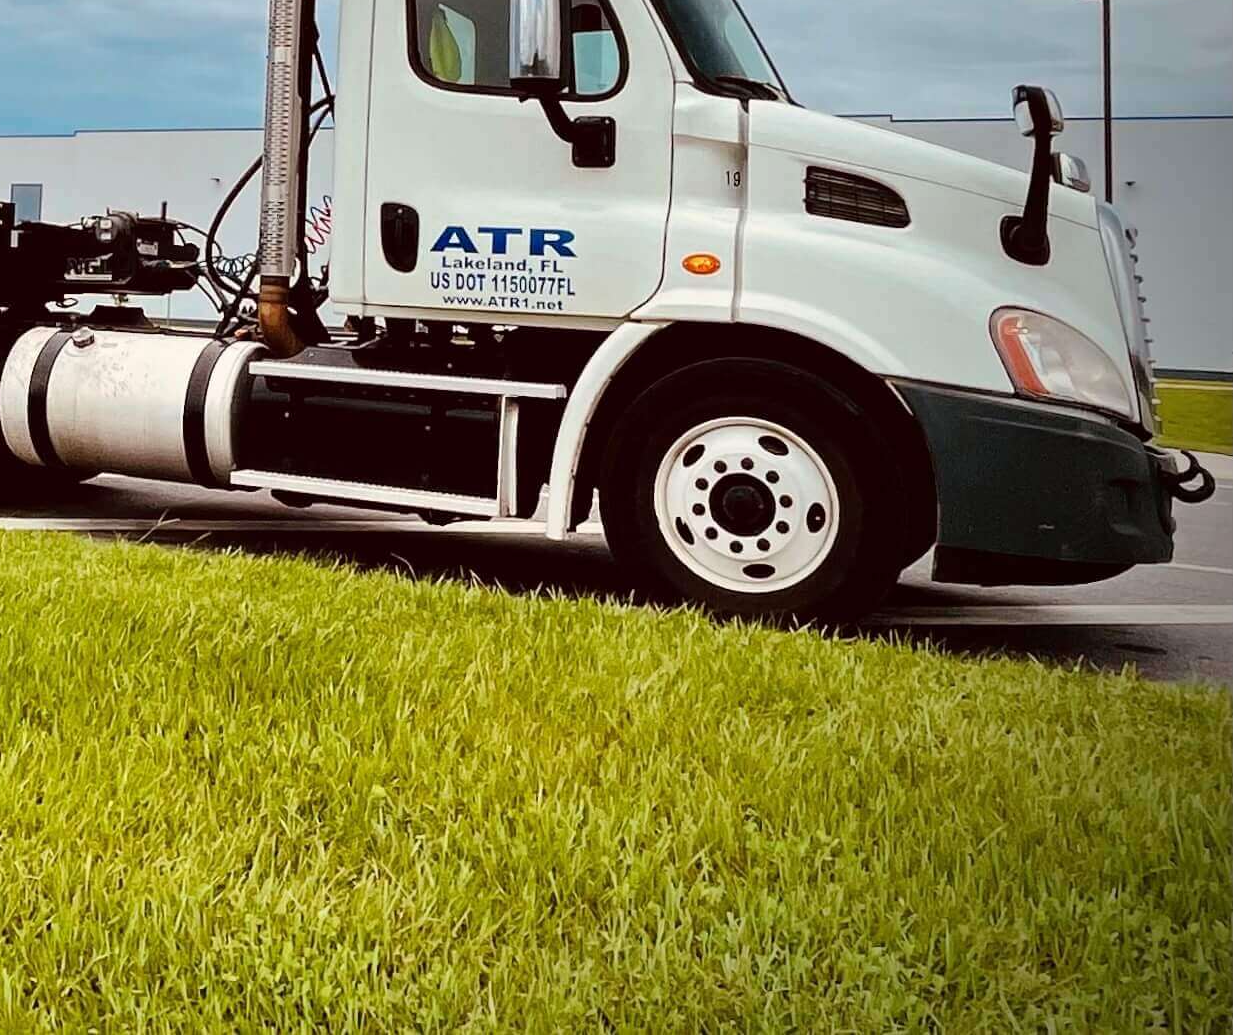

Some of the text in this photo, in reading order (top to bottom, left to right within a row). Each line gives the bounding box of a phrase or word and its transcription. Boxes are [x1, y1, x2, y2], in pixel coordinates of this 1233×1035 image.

[725, 170, 741, 187] 19
[429, 226, 578, 258] ATR
[441, 256, 564, 274] Lakeland, FL
[430, 271, 576, 296] US DOT 1150077FL
[442, 296, 564, 311] www.ATR1.net
